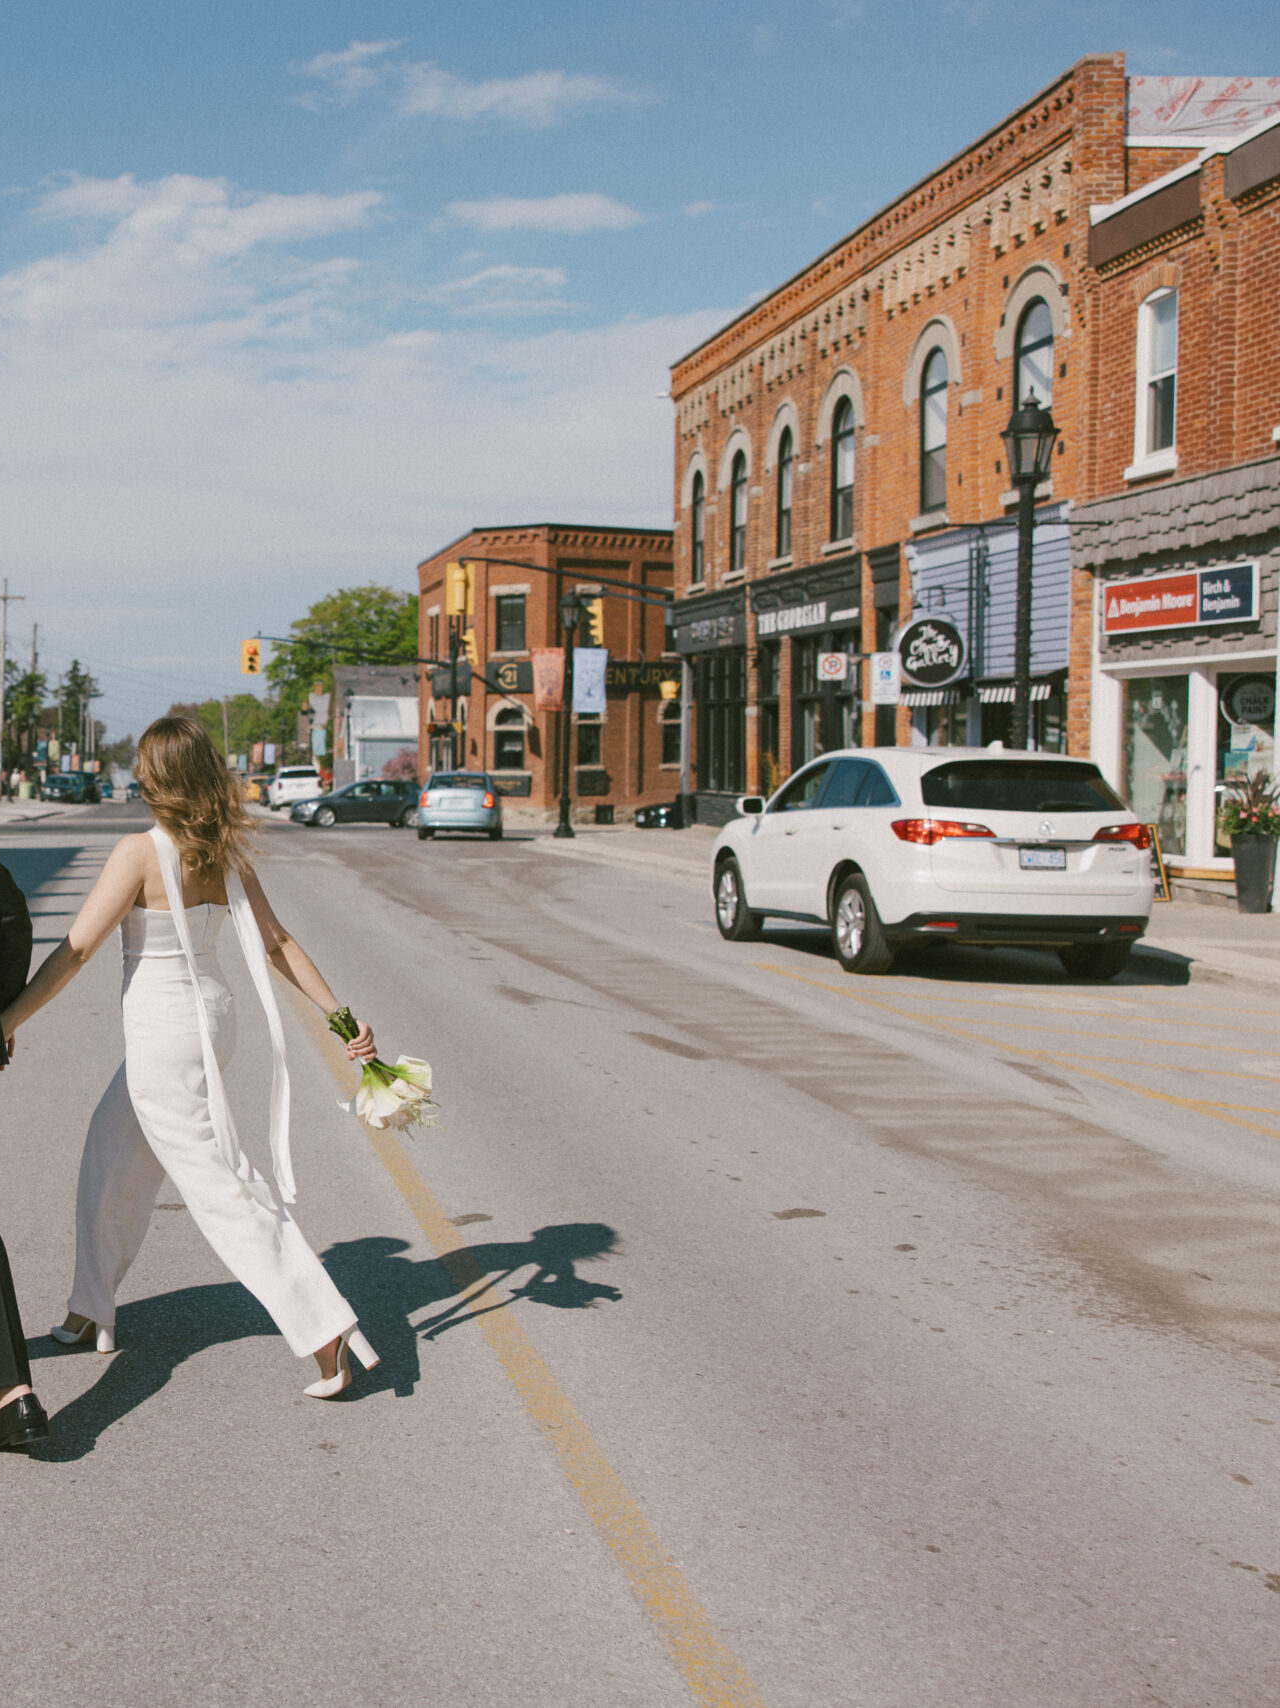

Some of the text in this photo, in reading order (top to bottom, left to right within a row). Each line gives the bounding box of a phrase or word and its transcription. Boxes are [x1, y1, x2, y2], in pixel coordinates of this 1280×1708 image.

[1203, 579, 1231, 596] Birch &
[1120, 593, 1194, 617] Benjamin Moore
[1202, 596, 1240, 613] Benjamin
[757, 611, 776, 635] THE
[776, 601, 827, 631] GEORGIAN
[918, 624, 938, 640] The
[906, 644, 959, 671] Gallery
[606, 667, 674, 685] ENTURY
[1240, 696, 1270, 705] CHALK
[1241, 705, 1267, 714] PAINT
